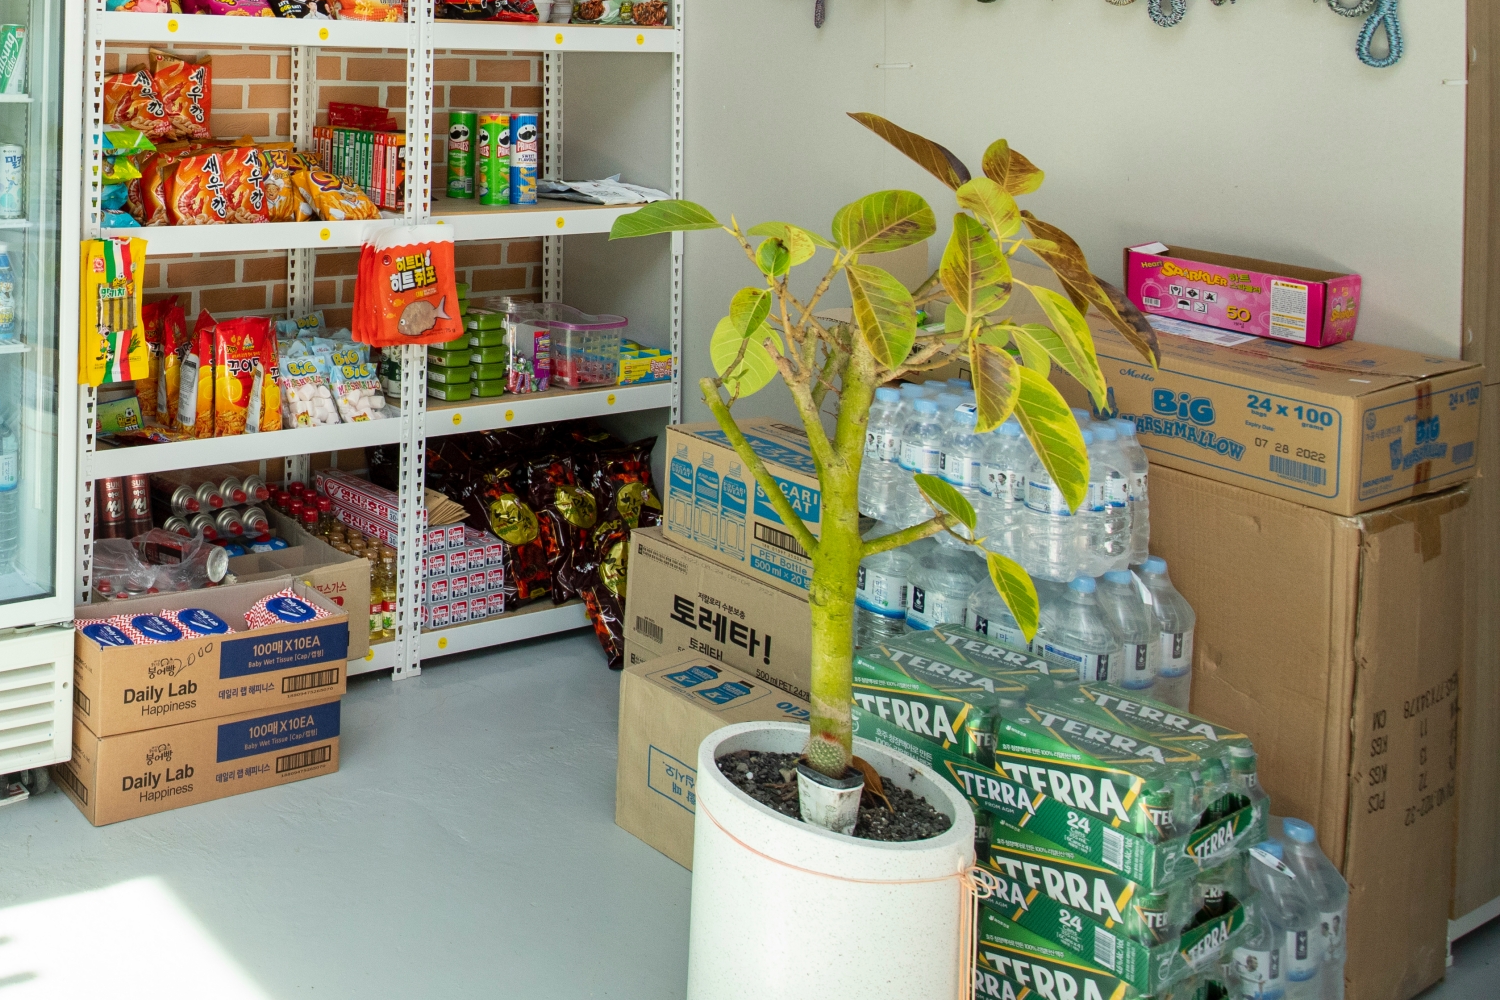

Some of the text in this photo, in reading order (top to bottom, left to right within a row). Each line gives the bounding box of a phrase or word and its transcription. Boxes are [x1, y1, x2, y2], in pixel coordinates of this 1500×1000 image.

[188, 65, 205, 124] 새우깡
[203, 154, 226, 218] 새우깡
[396, 253, 425, 272] 히트다
[1141, 260, 1163, 270] Heart
[389, 266, 438, 292] 히트쥐포
[1228, 272, 1251, 284] 하트
[1226, 306, 1251, 323] 50
[1119, 367, 1155, 383] Mello
[1247, 393, 1333, 428] 24 x 100
[1120, 413, 1247, 462] MARSHMALLOW
[1254, 437, 1327, 463] 07 28 2022
[754, 558, 771, 574] 500
[772, 566, 781, 577] ml
[791, 574, 803, 586] 20
[758, 550, 808, 576] PET Bottle
[697, 592, 746, 620] 저칼로리 수분보충
[669, 594, 772, 666] 토레타!
[248, 659, 263, 668] Baby
[263, 656, 276, 666] Wet
[277, 653, 294, 664] Tissue
[943, 632, 1050, 675] TERRA
[148, 664, 176, 680] 붕어빵
[889, 648, 995, 694] TERRA
[123, 679, 198, 705] Daily Lab
[218, 682, 275, 700] 데일리 랩 해피니스
[141, 699, 197, 717] Happiness
[853, 692, 958, 744] TERRA
[1036, 709, 1166, 765] TERRA
[122, 764, 195, 792] Daily Lab
[957, 769, 1036, 816] TERRA
[1001, 762, 1131, 823] TERRA
[1067, 811, 1091, 834] 24
[995, 855, 1124, 925] TERRA
